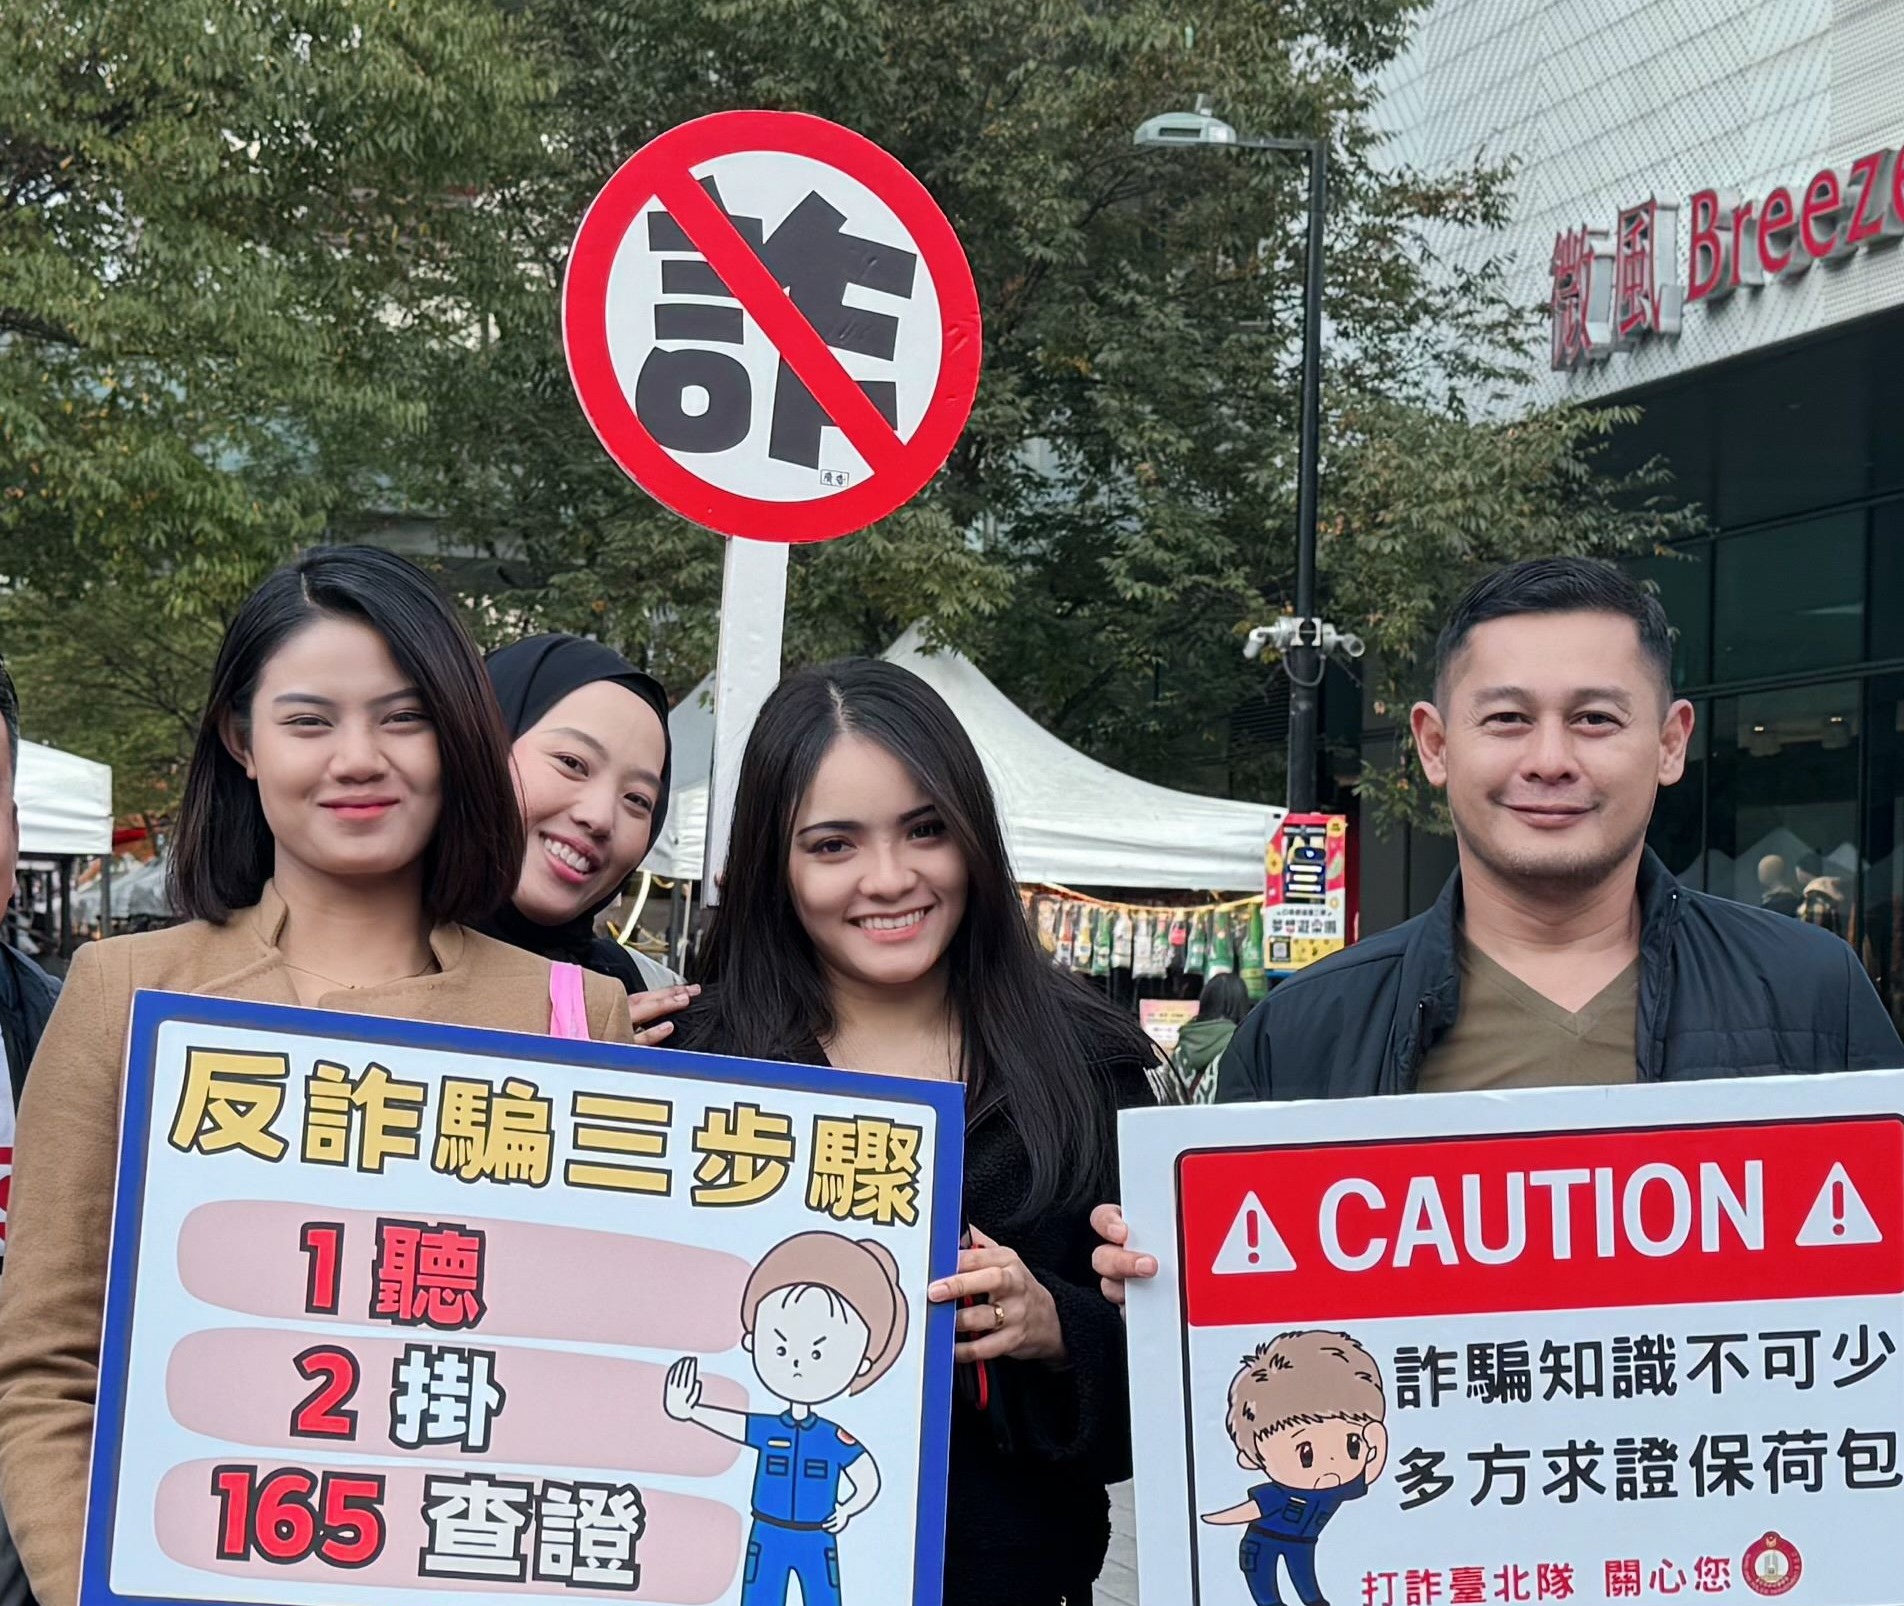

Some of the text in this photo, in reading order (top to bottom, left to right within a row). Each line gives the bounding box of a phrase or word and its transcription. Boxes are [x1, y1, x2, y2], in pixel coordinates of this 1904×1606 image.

[635, 174, 917, 470] 詐
[168, 1045, 925, 1228] 反詐騙三步驟
[1317, 1159, 1766, 1273] CAUTION
[299, 1218, 488, 1331] 1 聽
[289, 1343, 507, 1455] 2 掛
[1393, 1323, 1899, 1410] 詐騙知識不可少
[1393, 1426, 1904, 1512] 多方求證保荷包
[210, 1465, 647, 1593] 165 查證
[1603, 1554, 1732, 1601] 關心您
